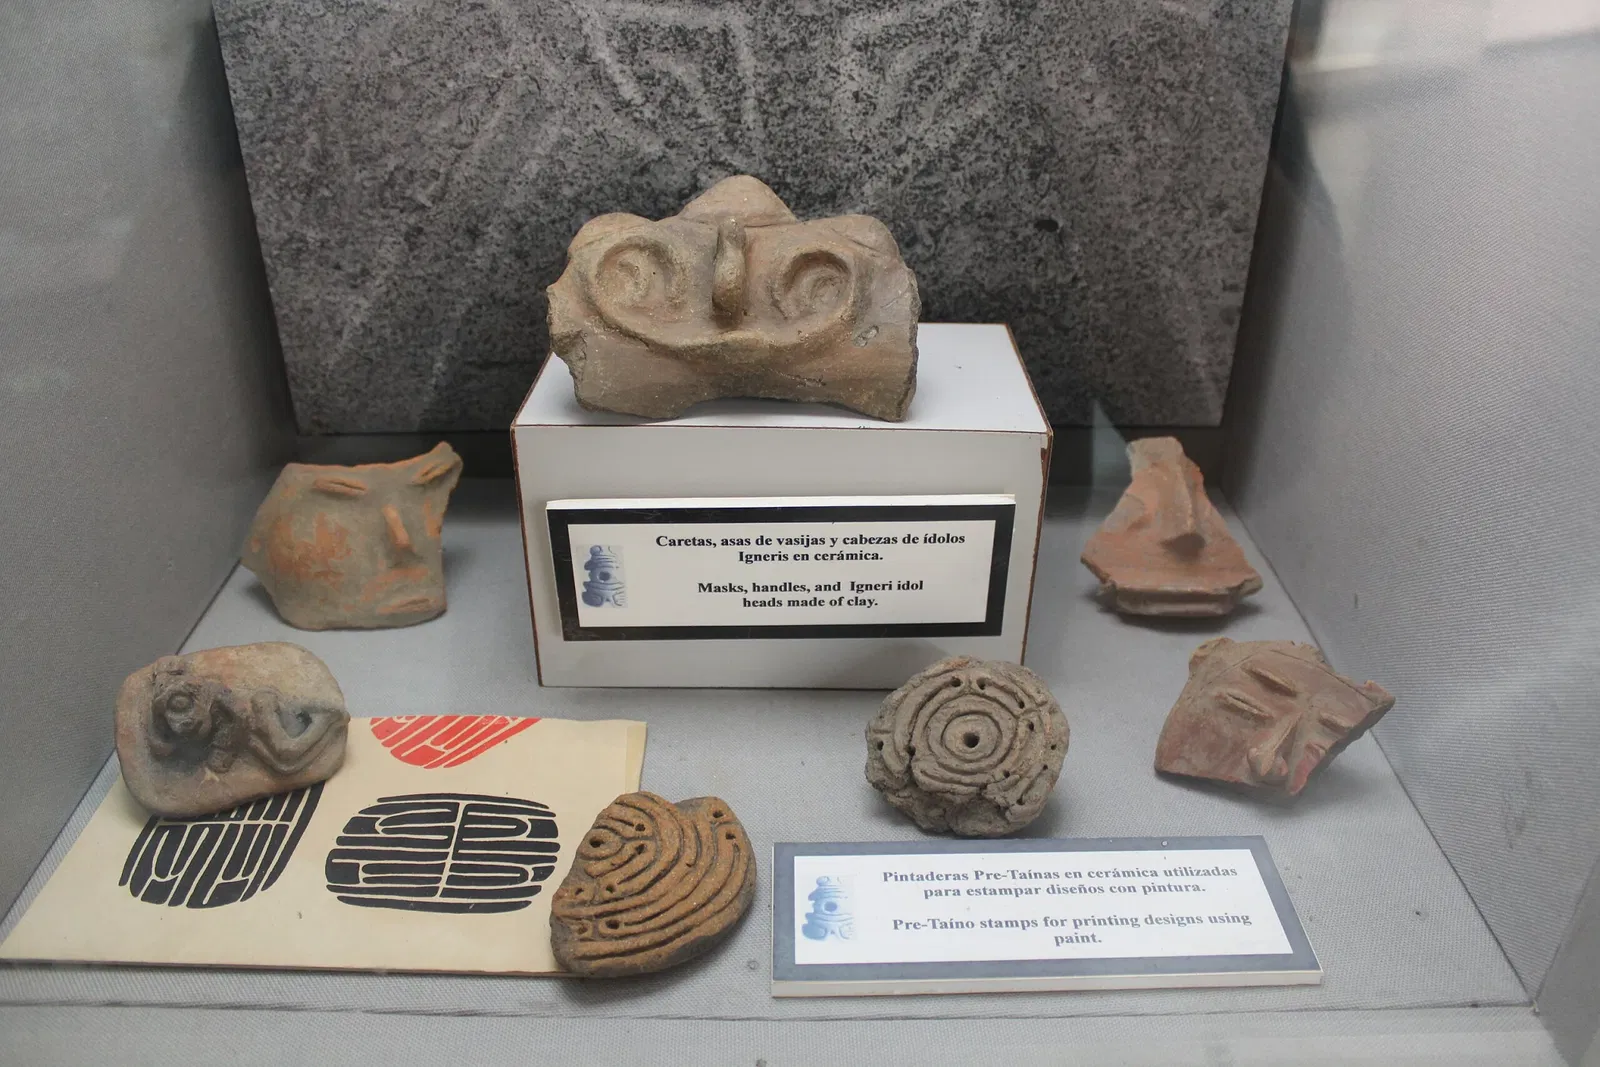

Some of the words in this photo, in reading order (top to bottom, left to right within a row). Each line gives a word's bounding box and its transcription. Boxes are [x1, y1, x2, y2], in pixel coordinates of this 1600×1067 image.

[655, 535, 718, 549] Caretas,
[720, 537, 752, 547] asas
[754, 534, 773, 547] de
[775, 534, 826, 549] vasijas
[828, 537, 839, 548] y
[841, 533, 899, 546] cabezas
[901, 533, 920, 545] de
[922, 532, 966, 545] ídolos
[738, 550, 790, 565] Igneris
[792, 553, 810, 562] en
[813, 549, 884, 562] cerámica.
[697, 582, 749, 595] Masks,
[751, 581, 811, 595] handles,
[813, 581, 842, 593] and
[849, 580, 893, 595] Igneri
[896, 579, 924, 591] idol
[742, 596, 784, 608] heads
[786, 596, 826, 608] made
[828, 595, 846, 607] of
[846, 595, 879, 609] clay.
[882, 870, 970, 883] Pintaderas
[973, 869, 1061, 881] Pre-Taínas
[1064, 871, 1083, 880] en
[1086, 867, 1159, 879] cerámica
[1162, 865, 1238, 878] utilizadas
[923, 888, 962, 900] para
[965, 885, 1042, 899] estampar
[1045, 883, 1106, 895] diseños
[1108, 885, 1138, 894] con
[1141, 881, 1206, 896] pintura.
[892, 917, 976, 931] Pre-Taíno
[979, 918, 1039, 931] stamps
[1042, 915, 1068, 928] for
[1071, 914, 1141, 930] printing
[1143, 913, 1204, 928] designs
[1207, 912, 1253, 927] using
[1053, 931, 1103, 948] paint.
